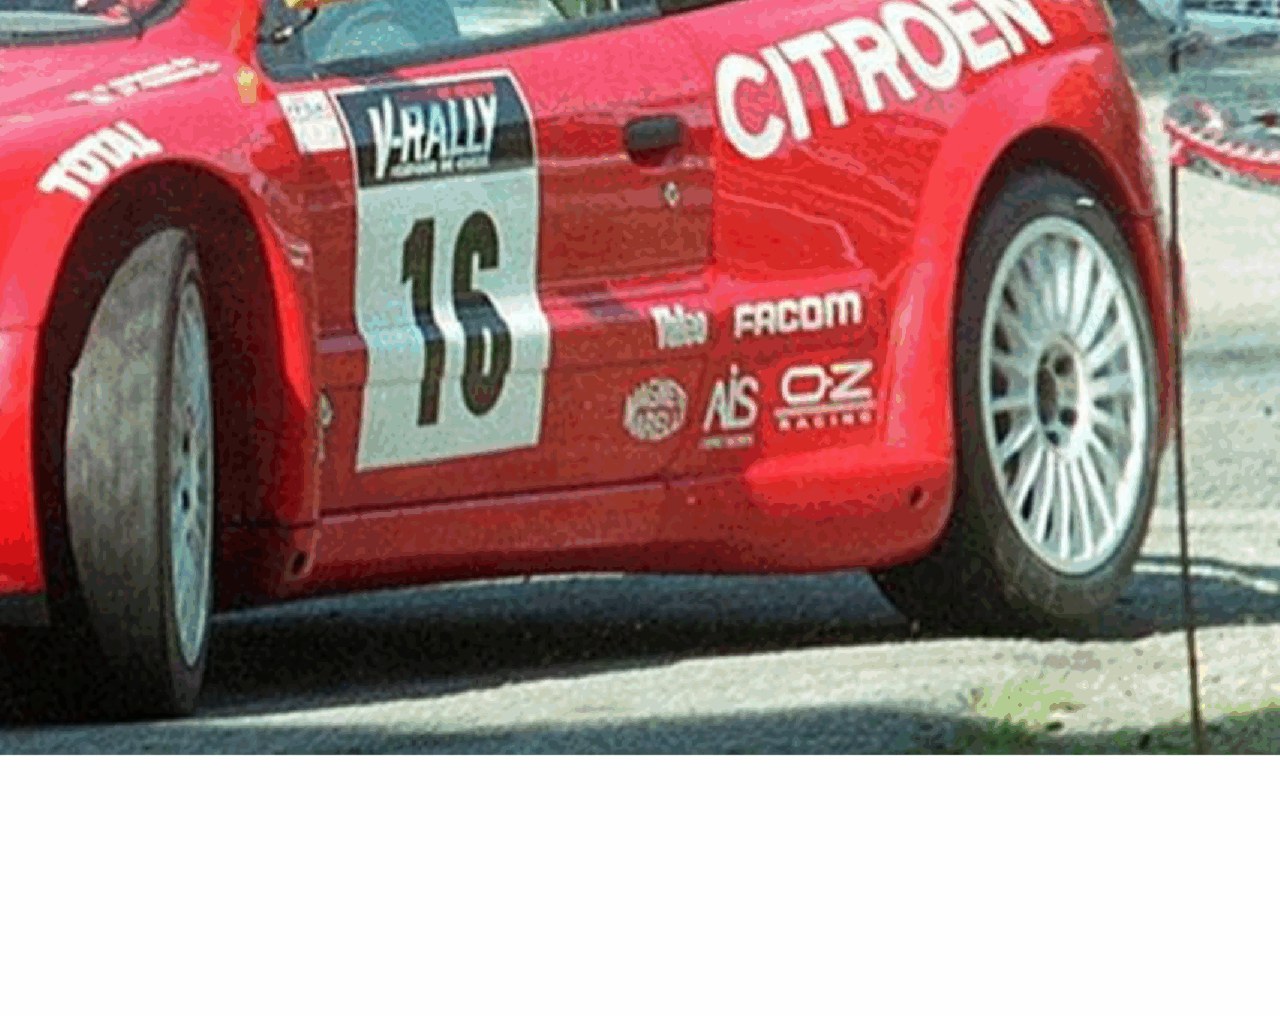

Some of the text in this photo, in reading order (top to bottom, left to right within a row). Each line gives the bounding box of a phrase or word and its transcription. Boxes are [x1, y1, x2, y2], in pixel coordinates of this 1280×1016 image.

[38, 120, 163, 201] TOTAL
[366, 93, 498, 180] V-RALLY
[401, 210, 512, 427] 16
[781, 358, 873, 405] OZ
